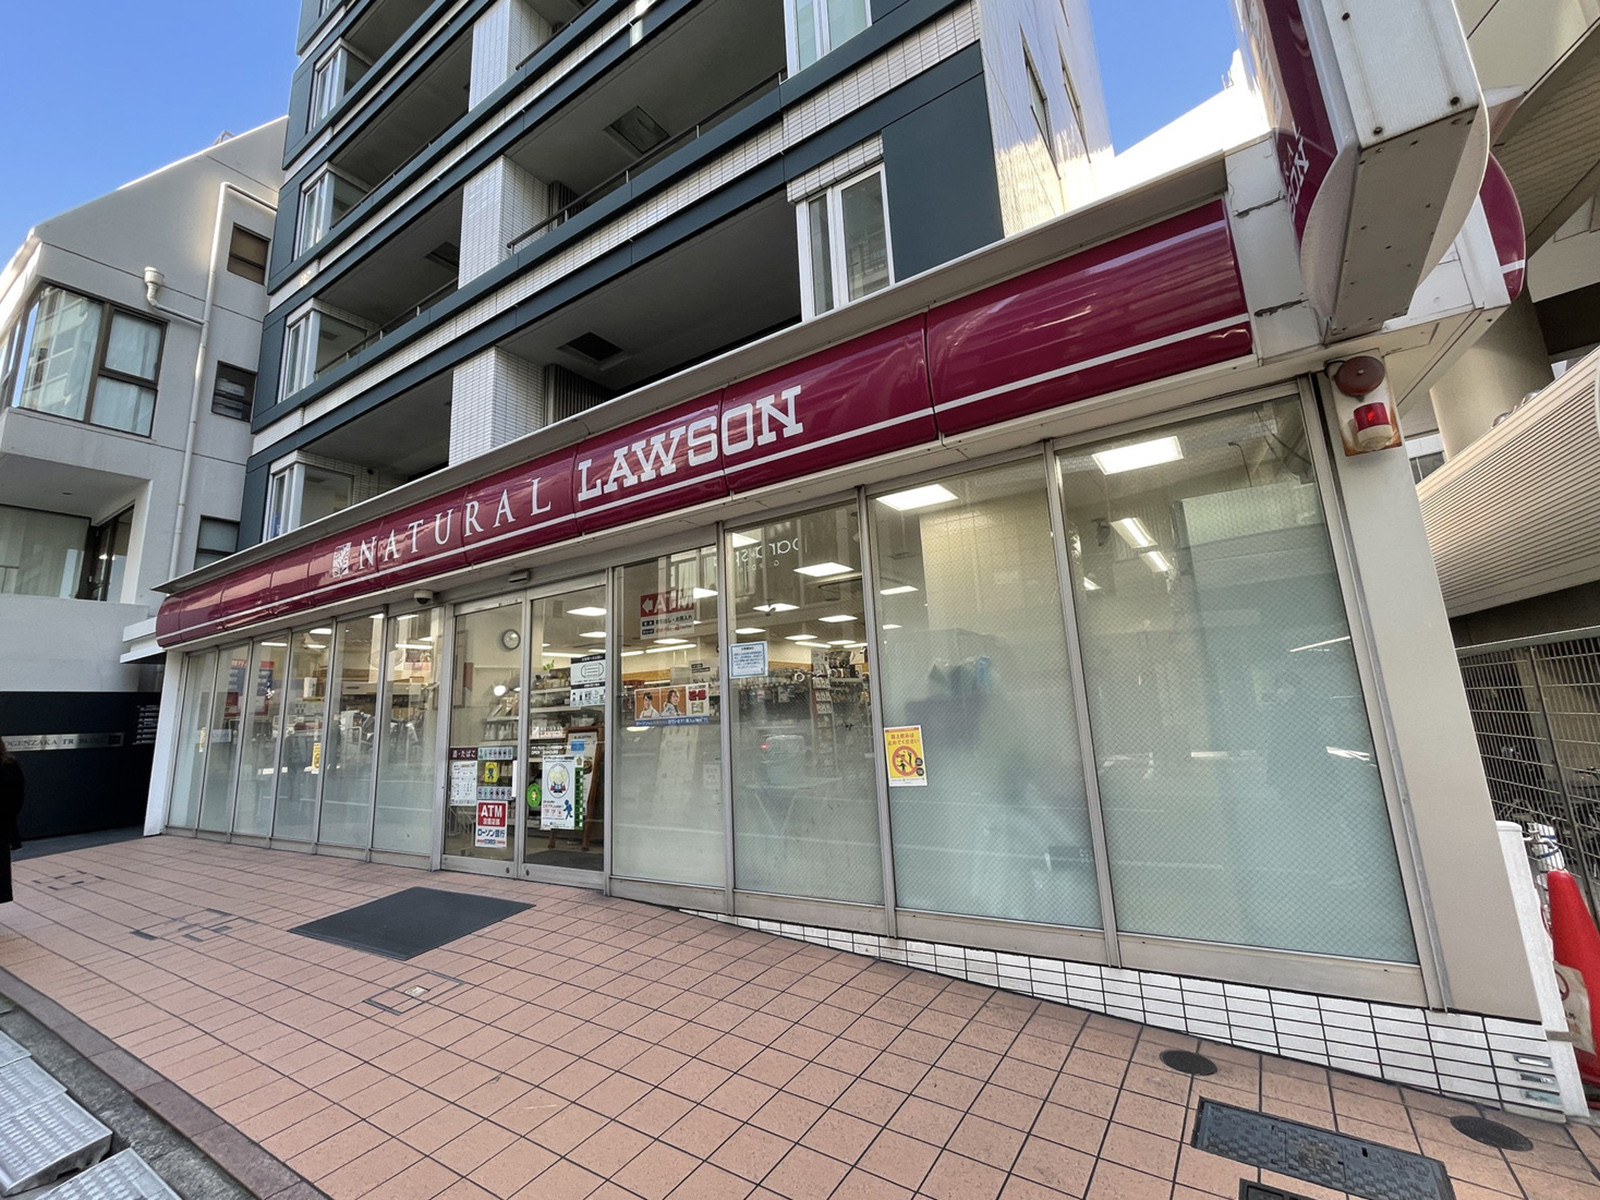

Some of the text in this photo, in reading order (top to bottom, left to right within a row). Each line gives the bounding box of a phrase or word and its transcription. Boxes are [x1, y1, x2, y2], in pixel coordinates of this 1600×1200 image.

[358, 384, 804, 570] NATURAL LAWSON
[481, 805, 503, 818] ATM
[477, 828, 505, 838] ローソン銀行
